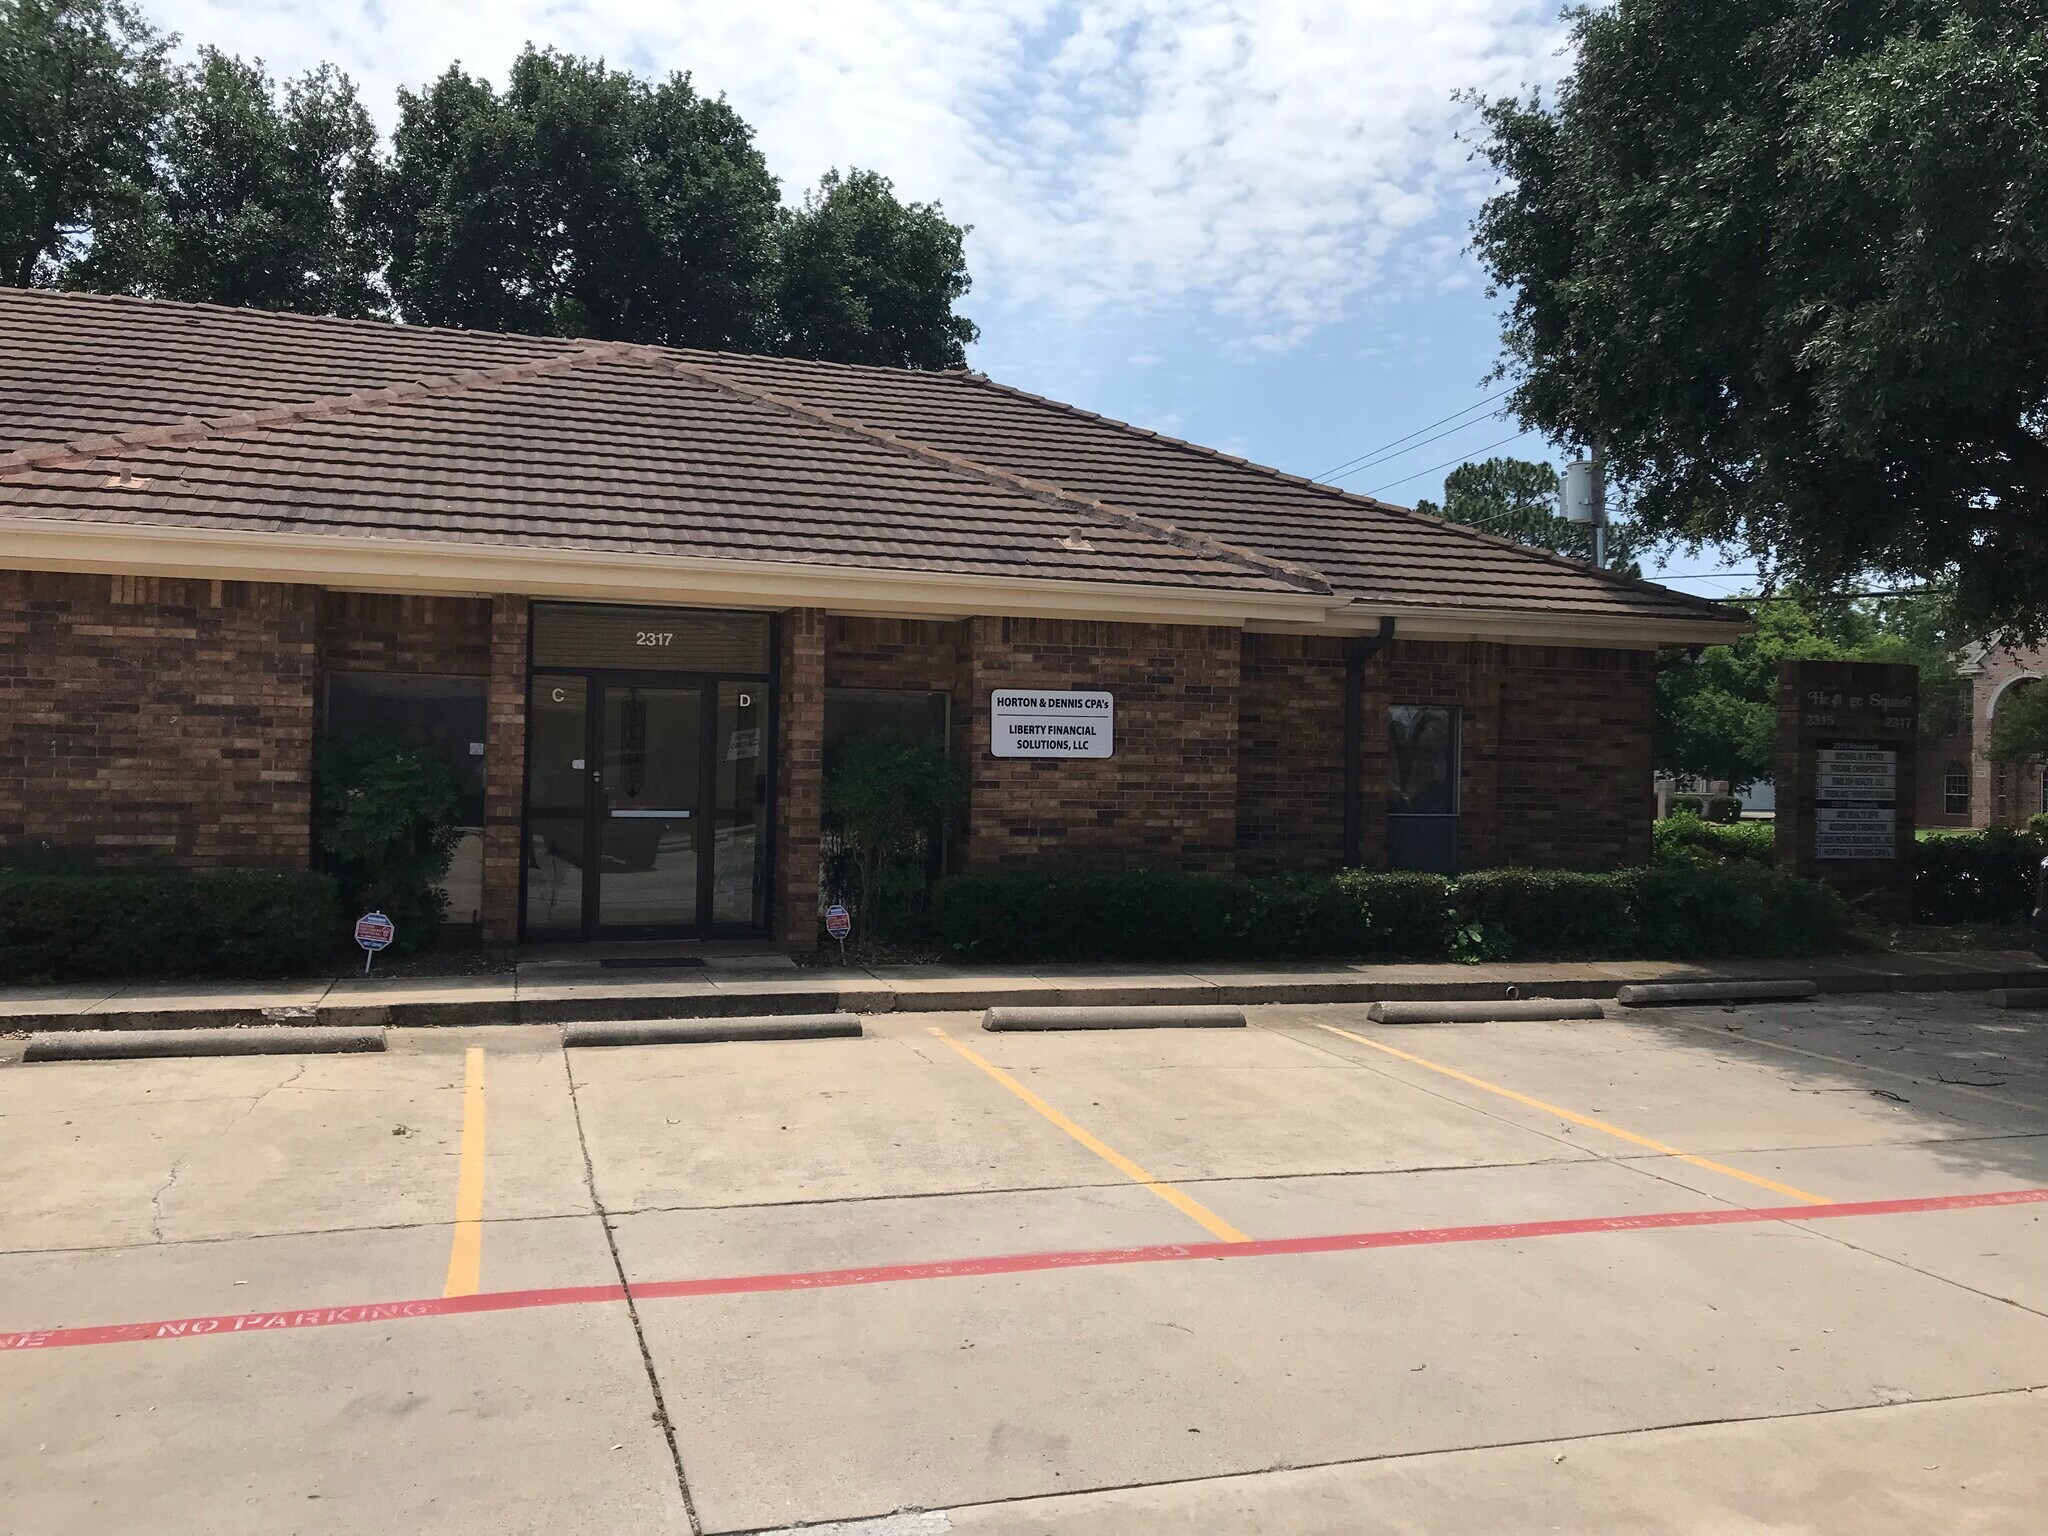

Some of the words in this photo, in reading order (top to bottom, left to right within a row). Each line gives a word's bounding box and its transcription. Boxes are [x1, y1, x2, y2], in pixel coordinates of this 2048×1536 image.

[636, 632, 673, 646] 2317
[552, 688, 565, 702] C
[739, 694, 751, 707] D
[997, 697, 1037, 708] HORTON
[1039, 698, 1046, 708] &
[1048, 698, 1083, 708] DENNIS
[1085, 699, 1109, 709] CPA's
[1806, 714, 1834, 727] 2315
[1884, 716, 1912, 729] 2317
[1009, 725, 1046, 735] LIBERTY
[1048, 726, 1096, 736] FINANCIAL
[1017, 740, 1071, 751] SOLUTIONS,
[1073, 740, 1089, 750] LLC
[155, 1321, 218, 1336] NO
[234, 1304, 434, 1330] PARKING
